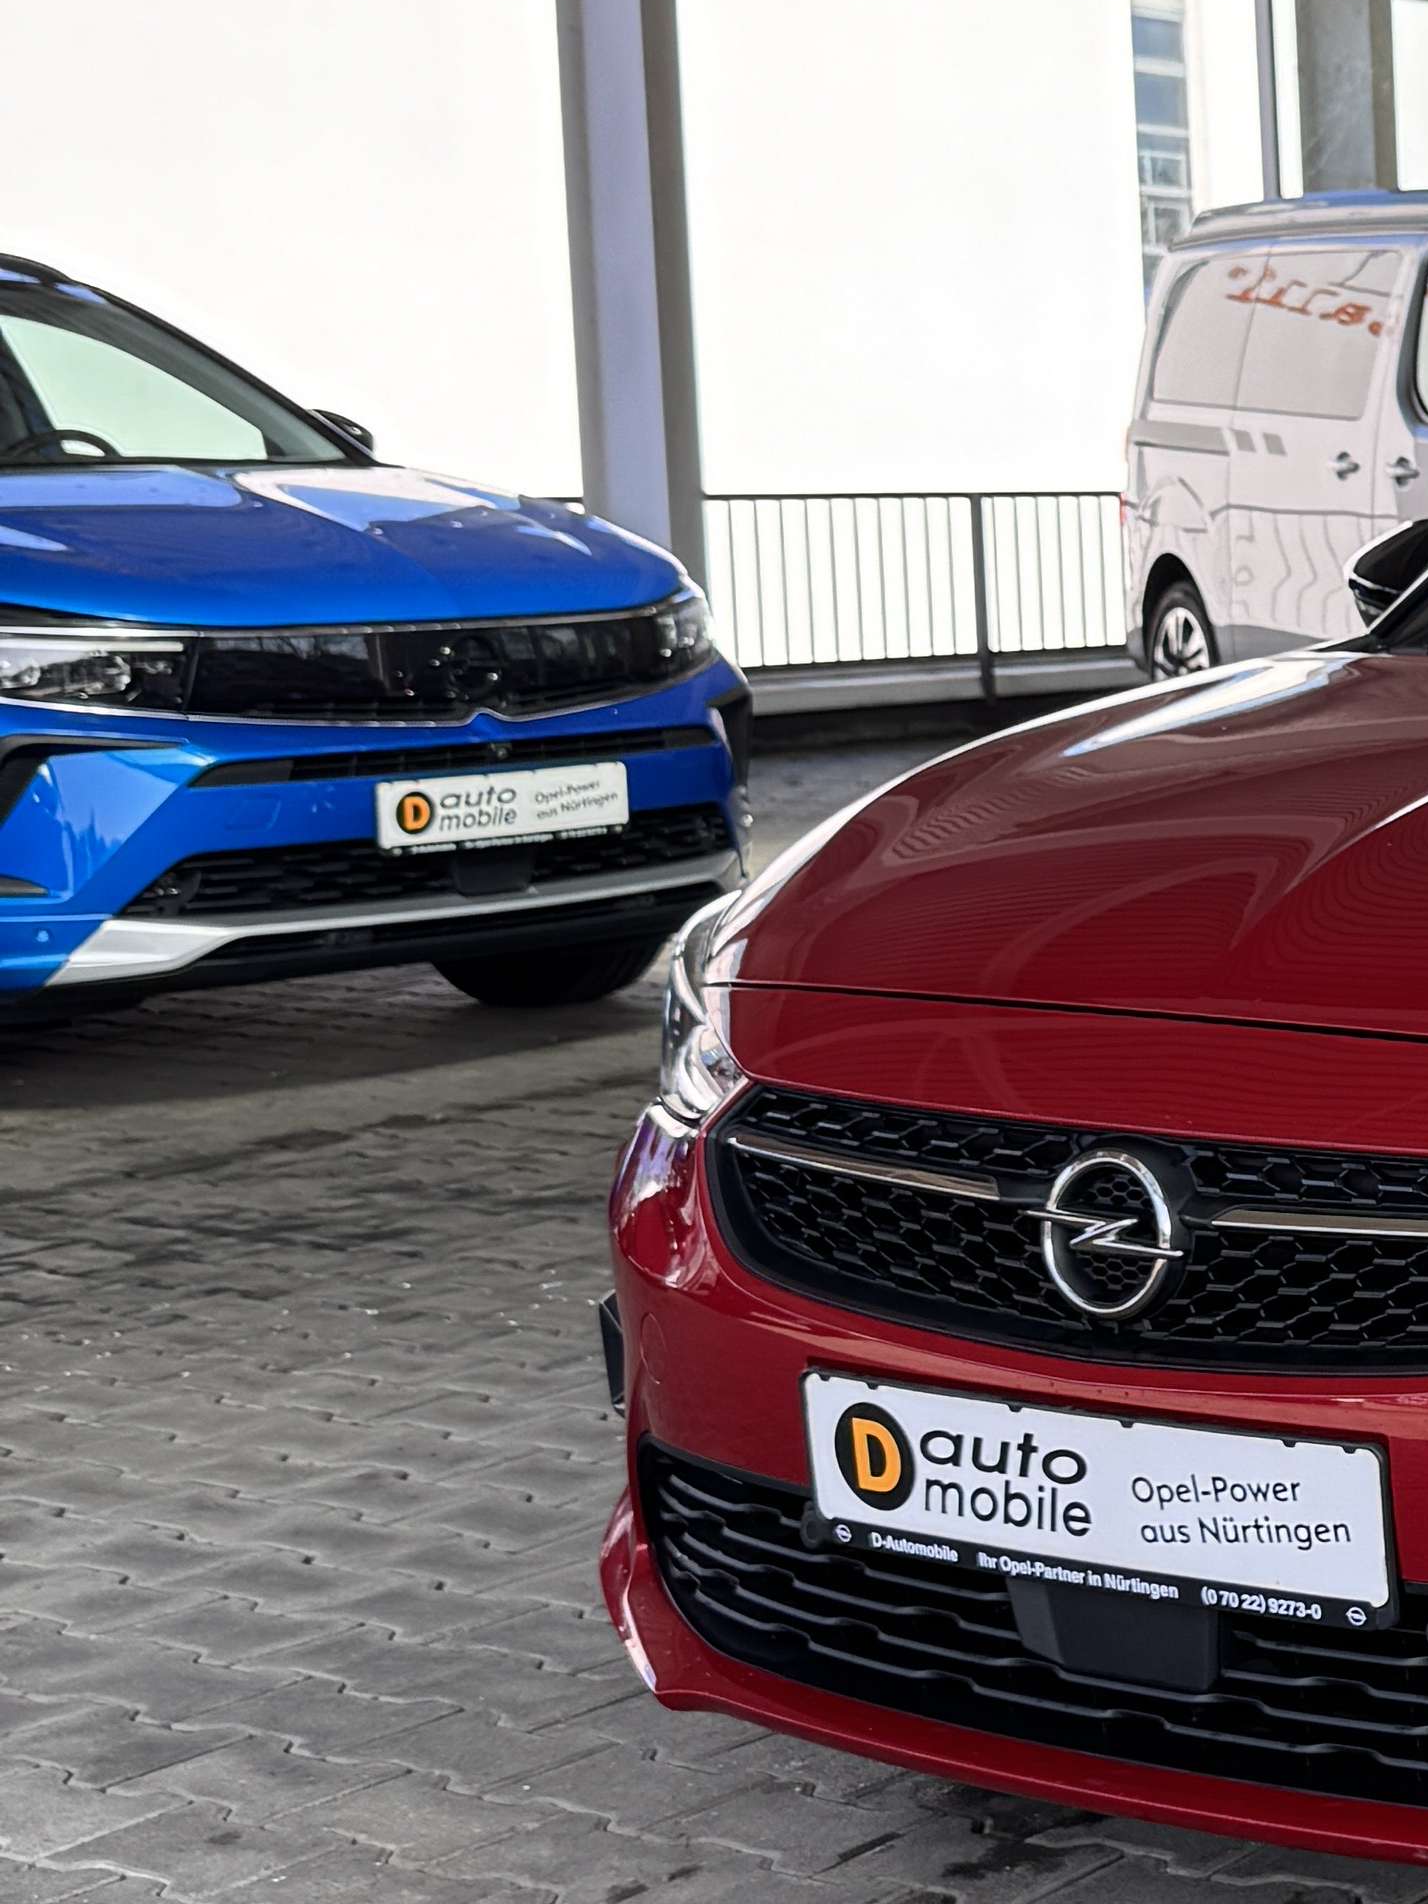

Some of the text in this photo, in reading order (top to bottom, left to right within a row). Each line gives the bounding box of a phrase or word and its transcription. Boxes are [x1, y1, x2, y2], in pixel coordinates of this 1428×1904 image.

[403, 786, 517, 831] D auto
[438, 806, 517, 832] mobile
[850, 1417, 1087, 1493] D auto
[923, 1476, 1092, 1538] mobile
[1131, 1475, 1301, 1511] Opel-Power
[870, 1532, 958, 1563] D-Automobile
[1141, 1517, 1351, 1550] aus Nürtingen
[977, 1551, 1180, 1601] Ihr Opel-Partner in Nürtingen
[1200, 1586, 1322, 1621] (0 70 22) 9273-0
